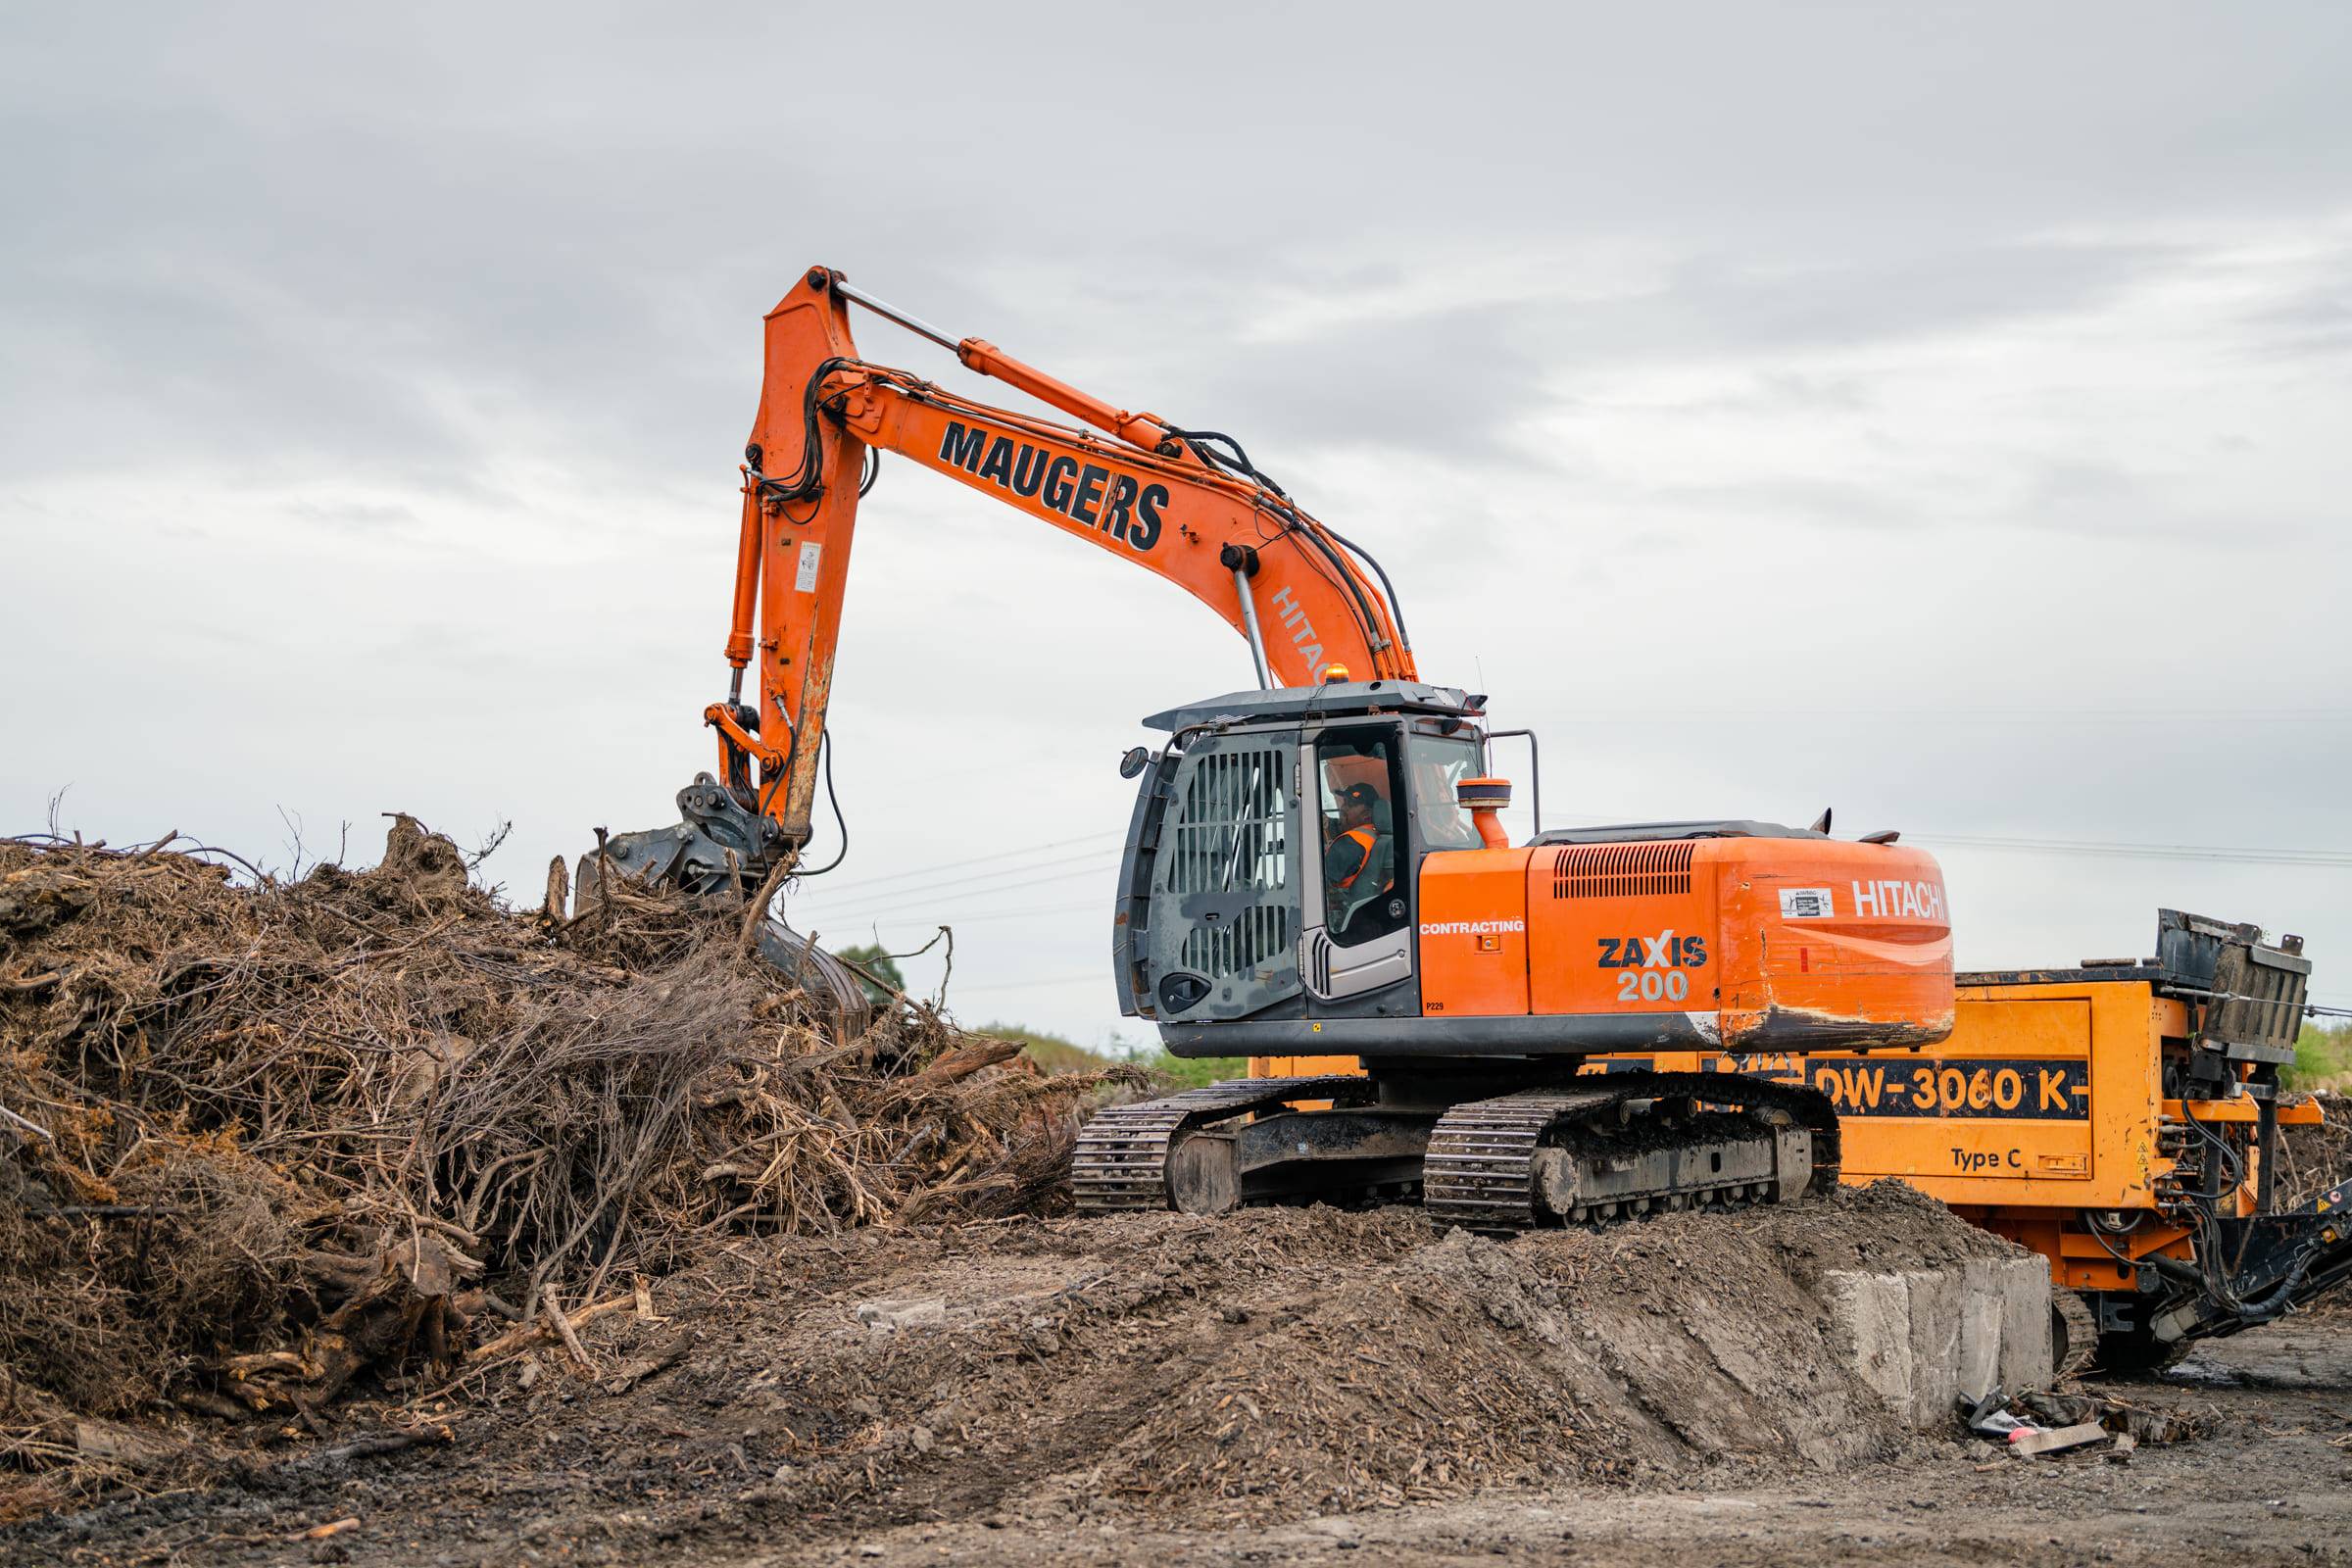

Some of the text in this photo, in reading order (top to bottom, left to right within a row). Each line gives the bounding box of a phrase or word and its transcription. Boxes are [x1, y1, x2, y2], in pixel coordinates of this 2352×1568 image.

[938, 420, 1170, 552] MAUGERS
[1272, 586, 1331, 687] HITAC
[1851, 880, 1945, 922] HITACHI
[1419, 920, 1525, 935] CONTRACTING
[1597, 929, 1708, 968] ZAXIS
[1617, 970, 1689, 1002] 200
[1426, 1002, 1445, 1011] P229
[1950, 1148, 2022, 1172] Type C
